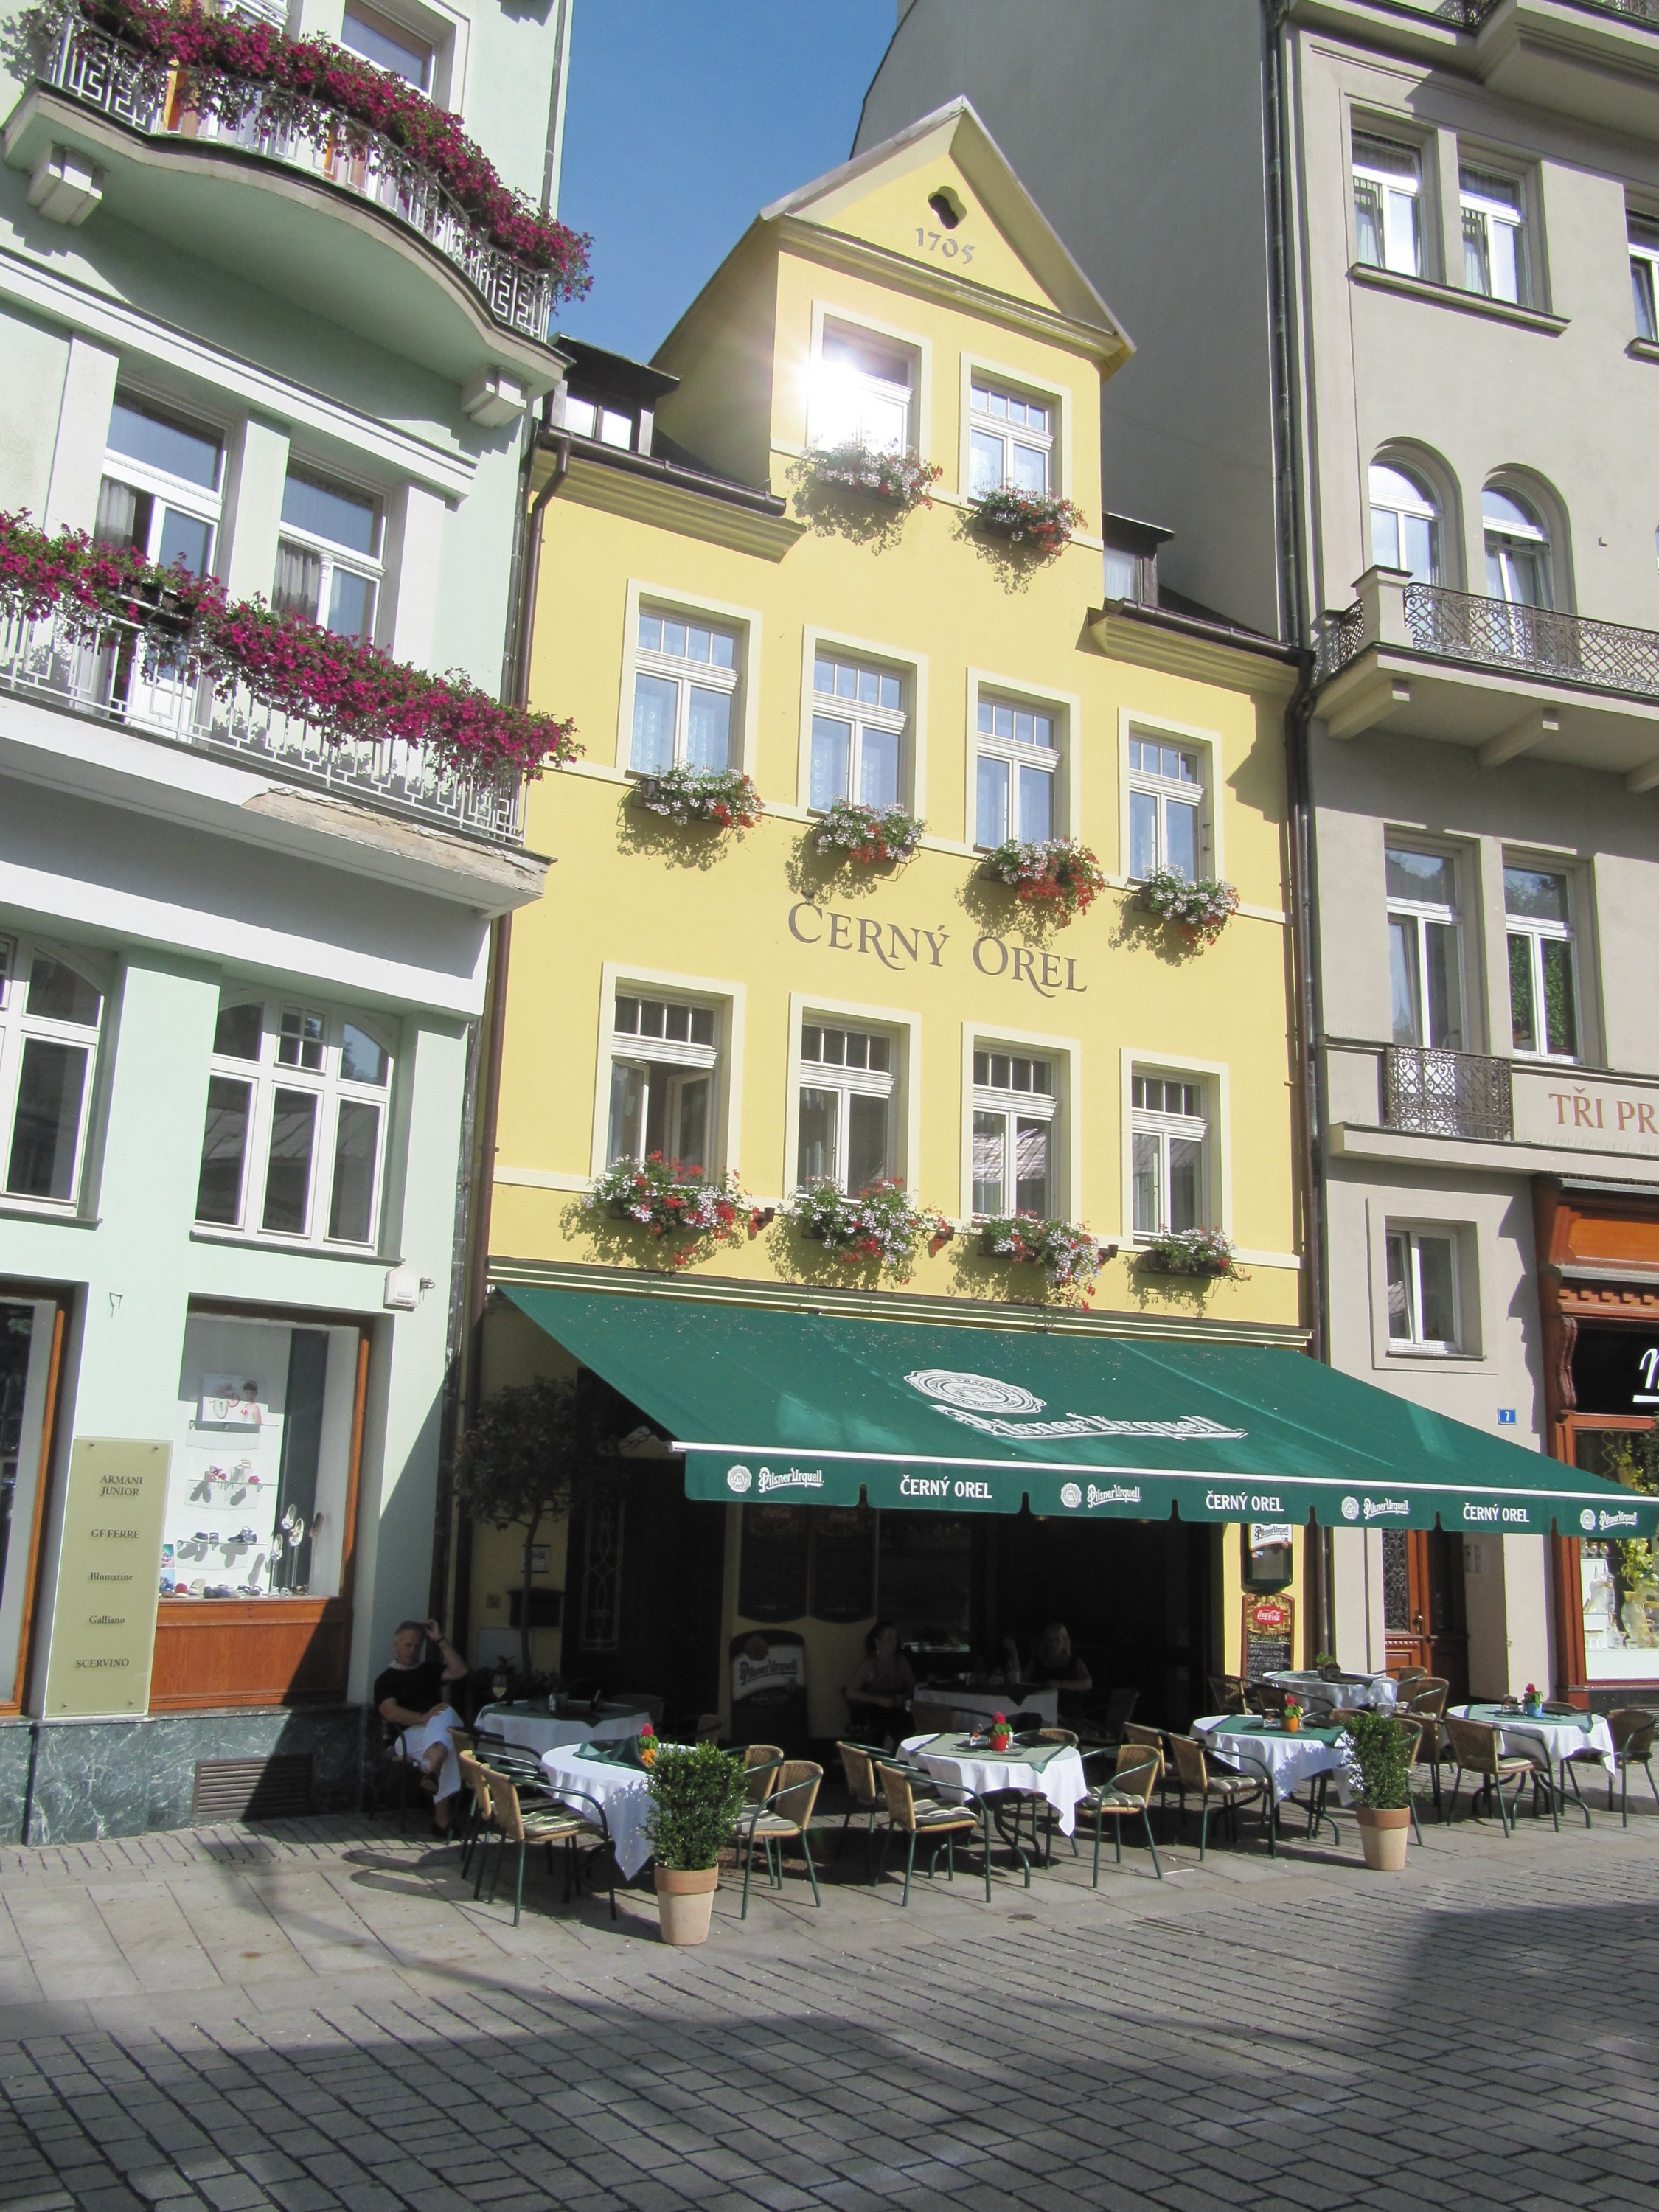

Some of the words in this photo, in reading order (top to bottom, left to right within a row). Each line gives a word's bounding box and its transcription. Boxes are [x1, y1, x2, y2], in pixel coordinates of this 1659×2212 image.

[916, 227, 975, 265] 1705
[788, 890, 950, 971] ČERNÝ
[973, 936, 1088, 998] OREL
[1548, 1085, 1604, 1129] TŘI
[1616, 1100, 1659, 1134] PR
[1504, 1411, 1510, 1422] 7
[100, 1475, 143, 1485] ARMANI
[758, 1466, 793, 1494] Pilsner
[790, 1467, 824, 1488] Urquell
[900, 1474, 950, 1497] ČERNÝ
[954, 1481, 992, 1499] OREL
[100, 1486, 139, 1497] JUNIOR
[1087, 1484, 1116, 1509] Pilsner
[1113, 1484, 1142, 1503] Urquell
[1205, 1489, 1248, 1510] ČERNÝ
[1251, 1496, 1284, 1512] OREL
[1363, 1498, 1387, 1520] Pilsner
[1385, 1498, 1410, 1515] Urquell
[1463, 1503, 1498, 1522] ČERNÝ
[1502, 1506, 1530, 1523] OREL
[1599, 1510, 1621, 1531] Pilsner
[1618, 1510, 1638, 1526] Urquell
[91, 1528, 105, 1538] GF
[108, 1529, 140, 1539] FERRE
[1254, 1525, 1274, 1541] Pilsner
[89, 1571, 133, 1581] Blumarine
[89, 1615, 125, 1624] Galliano
[75, 1658, 130, 1668] SCERVINO
